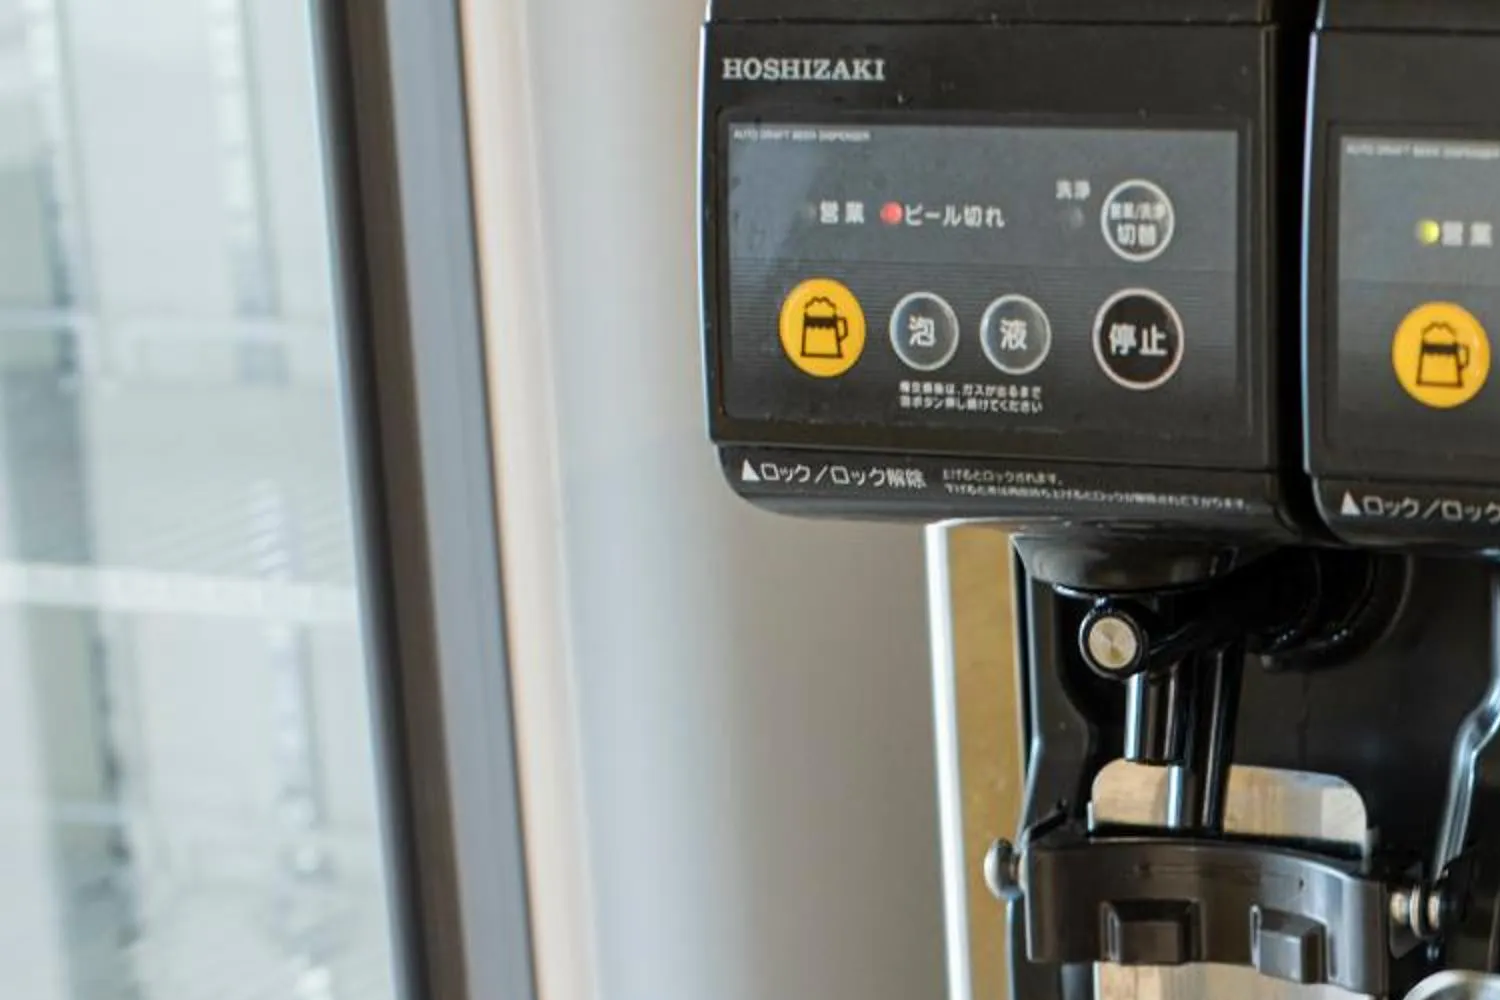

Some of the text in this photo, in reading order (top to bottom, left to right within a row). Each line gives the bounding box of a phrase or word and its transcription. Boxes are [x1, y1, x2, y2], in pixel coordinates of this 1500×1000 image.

[722, 57, 885, 80] HOSHIZAKI
[904, 204, 1006, 229] ビール切れ
[908, 315, 937, 348] 泡
[999, 318, 1028, 351] 液
[1109, 321, 1168, 357] 停止
